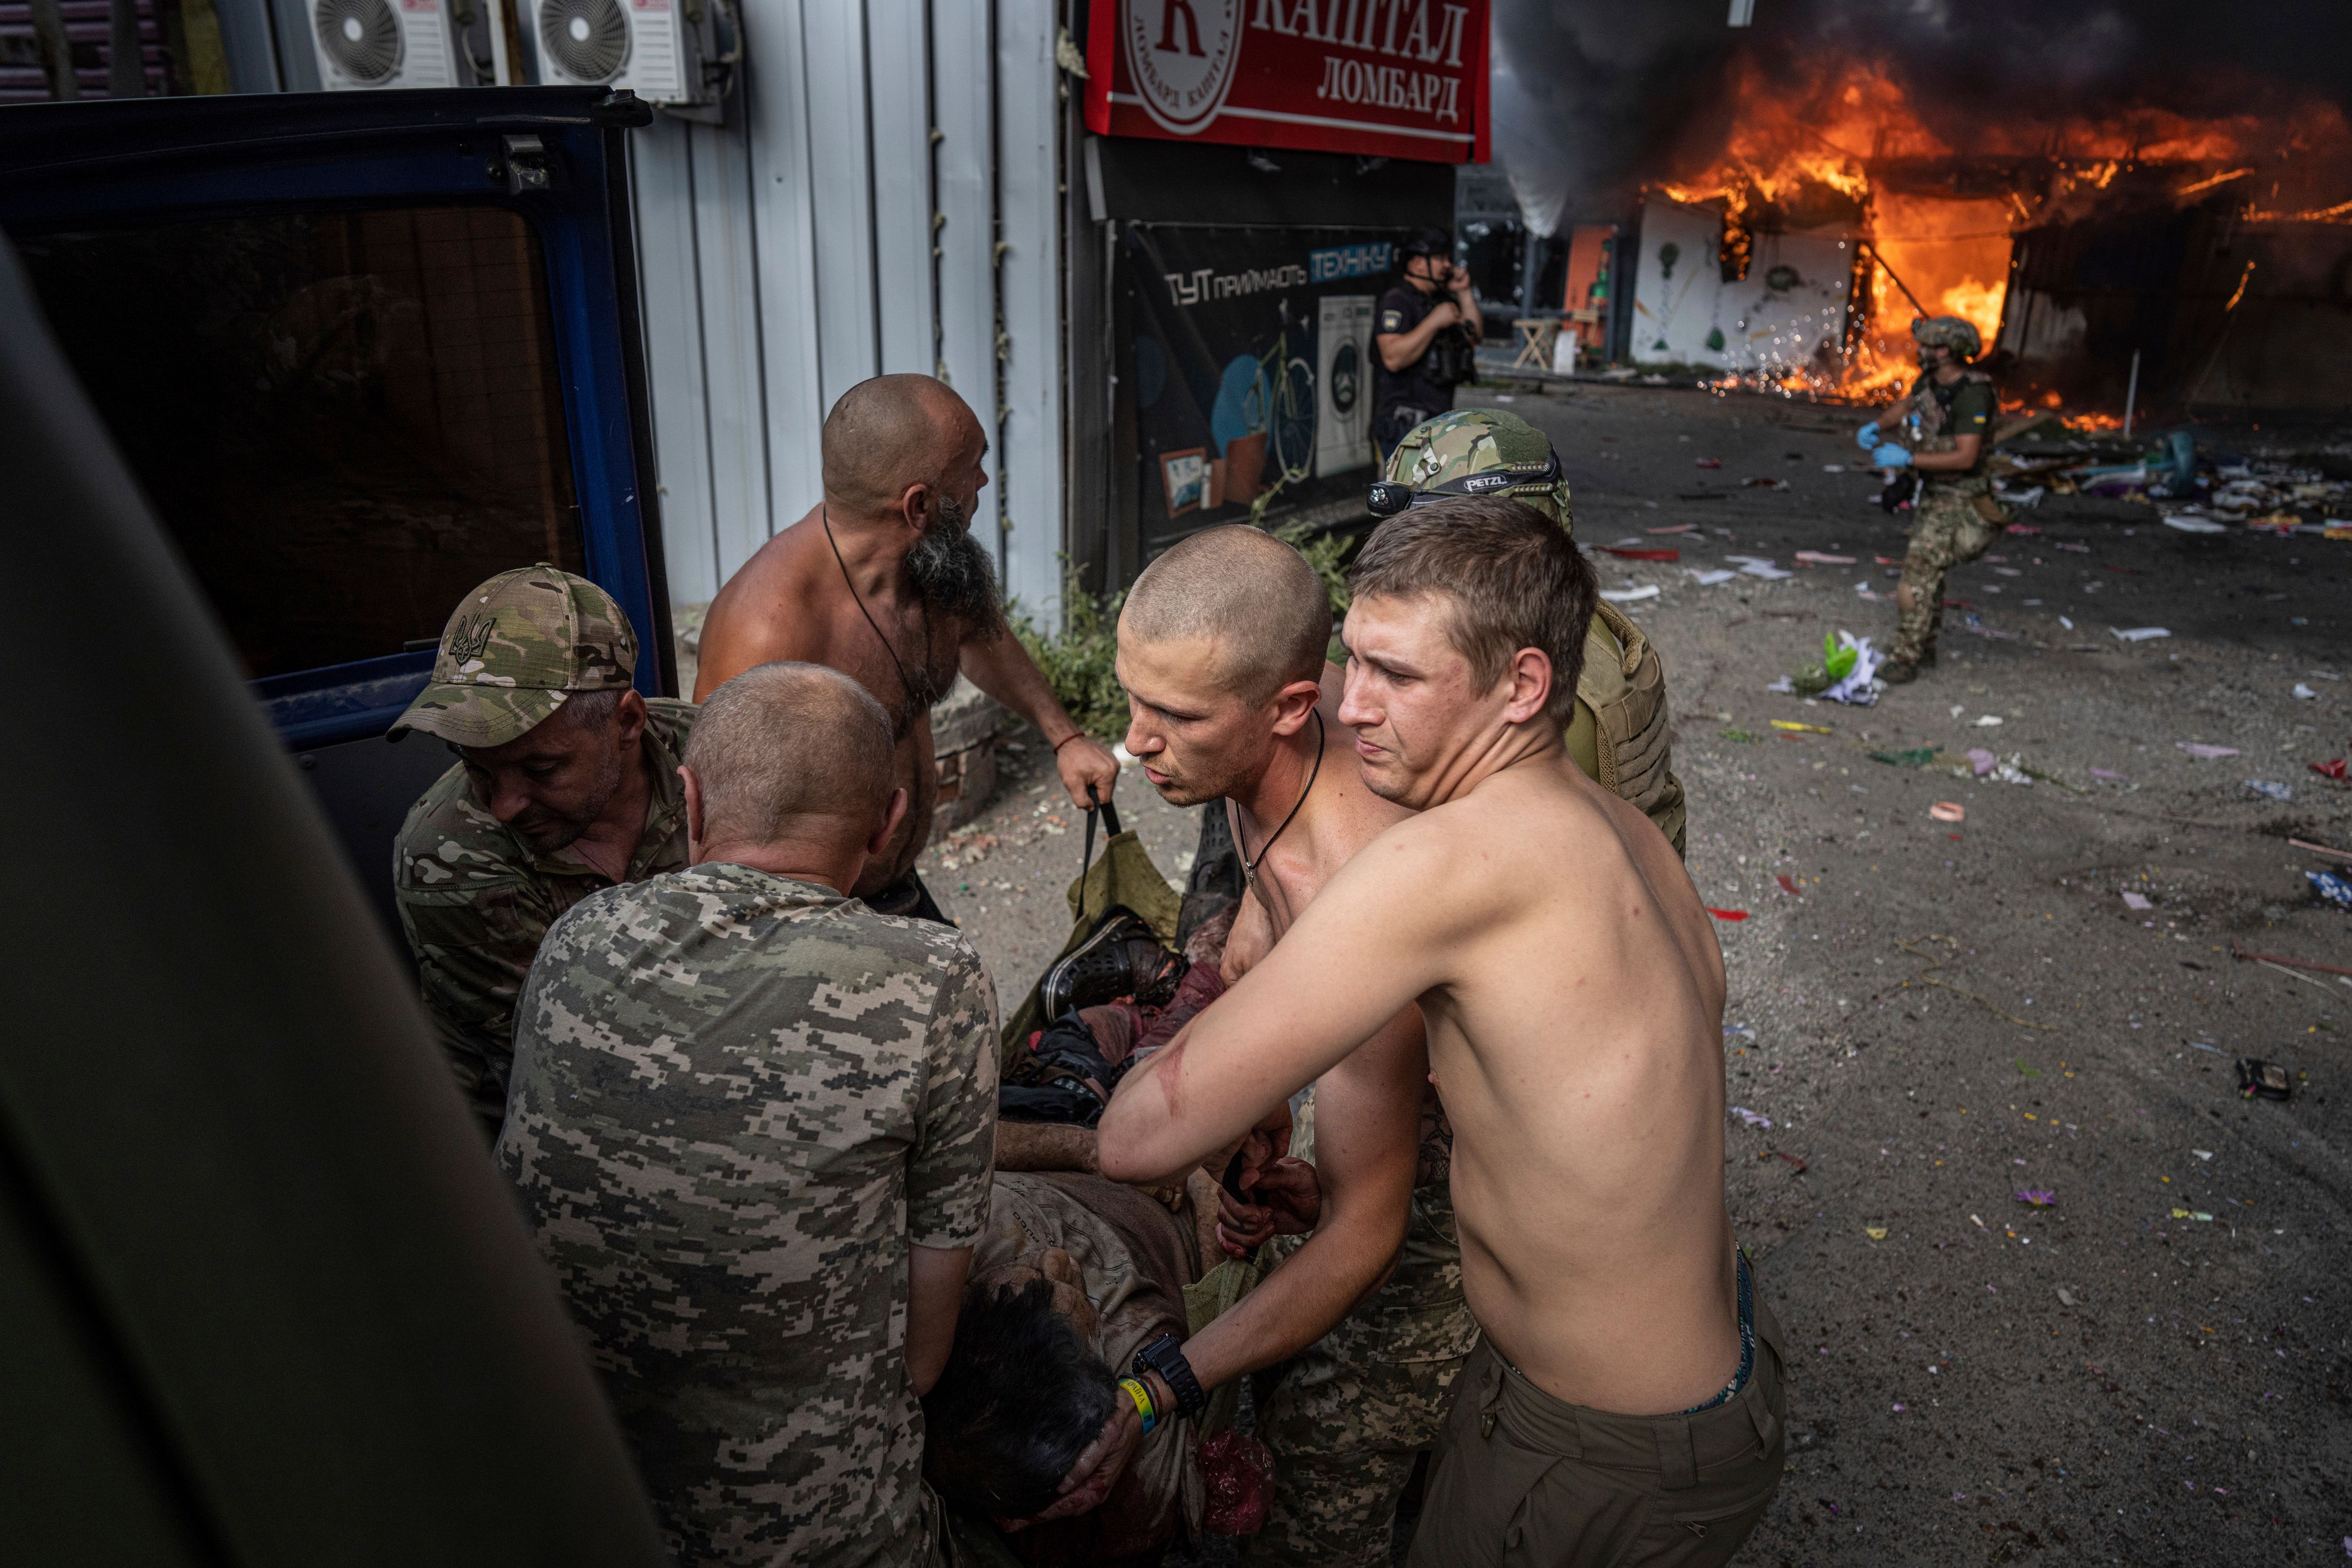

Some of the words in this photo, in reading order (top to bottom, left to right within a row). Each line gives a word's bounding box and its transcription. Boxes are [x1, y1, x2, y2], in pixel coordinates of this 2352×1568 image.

[1317, 56, 1462, 125] ЛОМБАРД
[1164, 268, 1214, 306] ТУТ
[1466, 476, 1508, 493] PETZL
